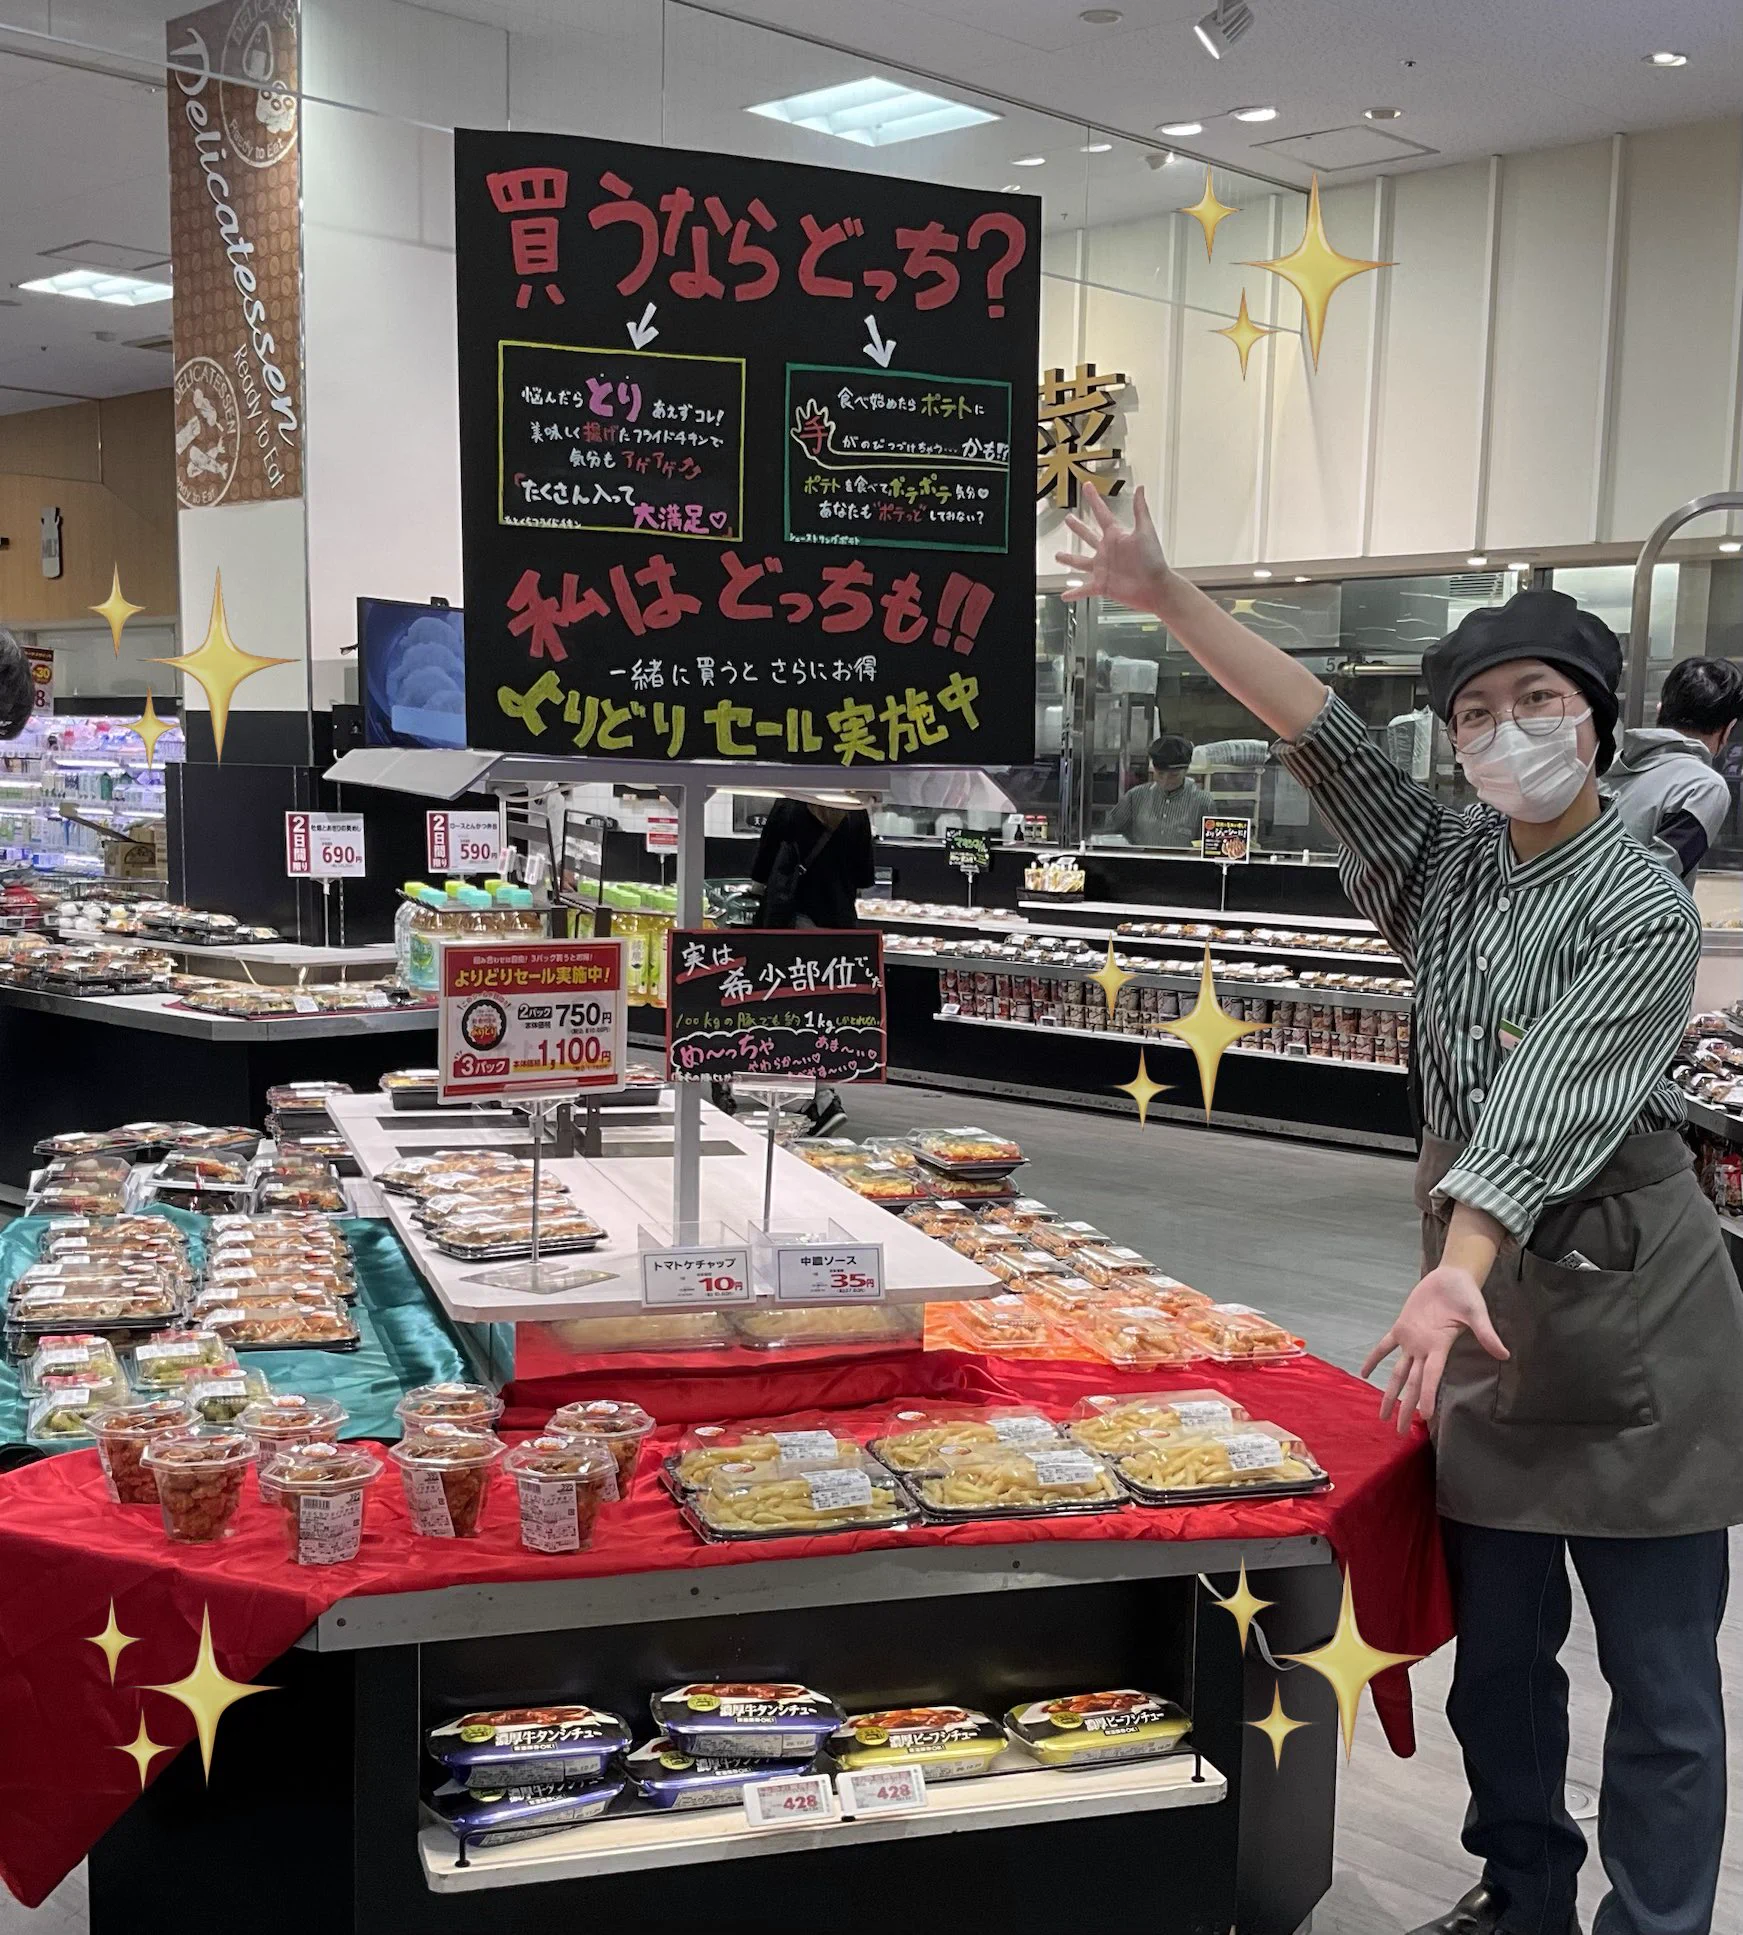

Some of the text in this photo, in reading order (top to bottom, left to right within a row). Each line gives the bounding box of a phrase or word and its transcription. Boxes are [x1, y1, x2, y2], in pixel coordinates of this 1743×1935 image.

[168, 27, 297, 447] Delicatessen
[486, 166, 1028, 319] 買うならどっち?
[175, 365, 237, 435] DELICATESSEN
[234, 343, 285, 489] Ready to Eat
[1326, 657, 1336, 672] 5
[681, 941, 735, 977] 実は
[454, 966, 611, 988] よりどりセール実施中!
[519, 1003, 552, 1019] 2パック
[461, 1055, 506, 1076] 3パック
[654, 1258, 737, 1272] トマトケチャップ
[719, 1703, 818, 1718] 濃厚牛タンシチュー
[1084, 1711, 1165, 1732] 濃厚ビーフシチュー
[494, 1727, 603, 1747] 濃厚牛タンシチュー
[888, 1729, 978, 1748] 濃厚ビーフシチュー
[783, 1794, 818, 1811] 428
[877, 1784, 911, 1801] 428
